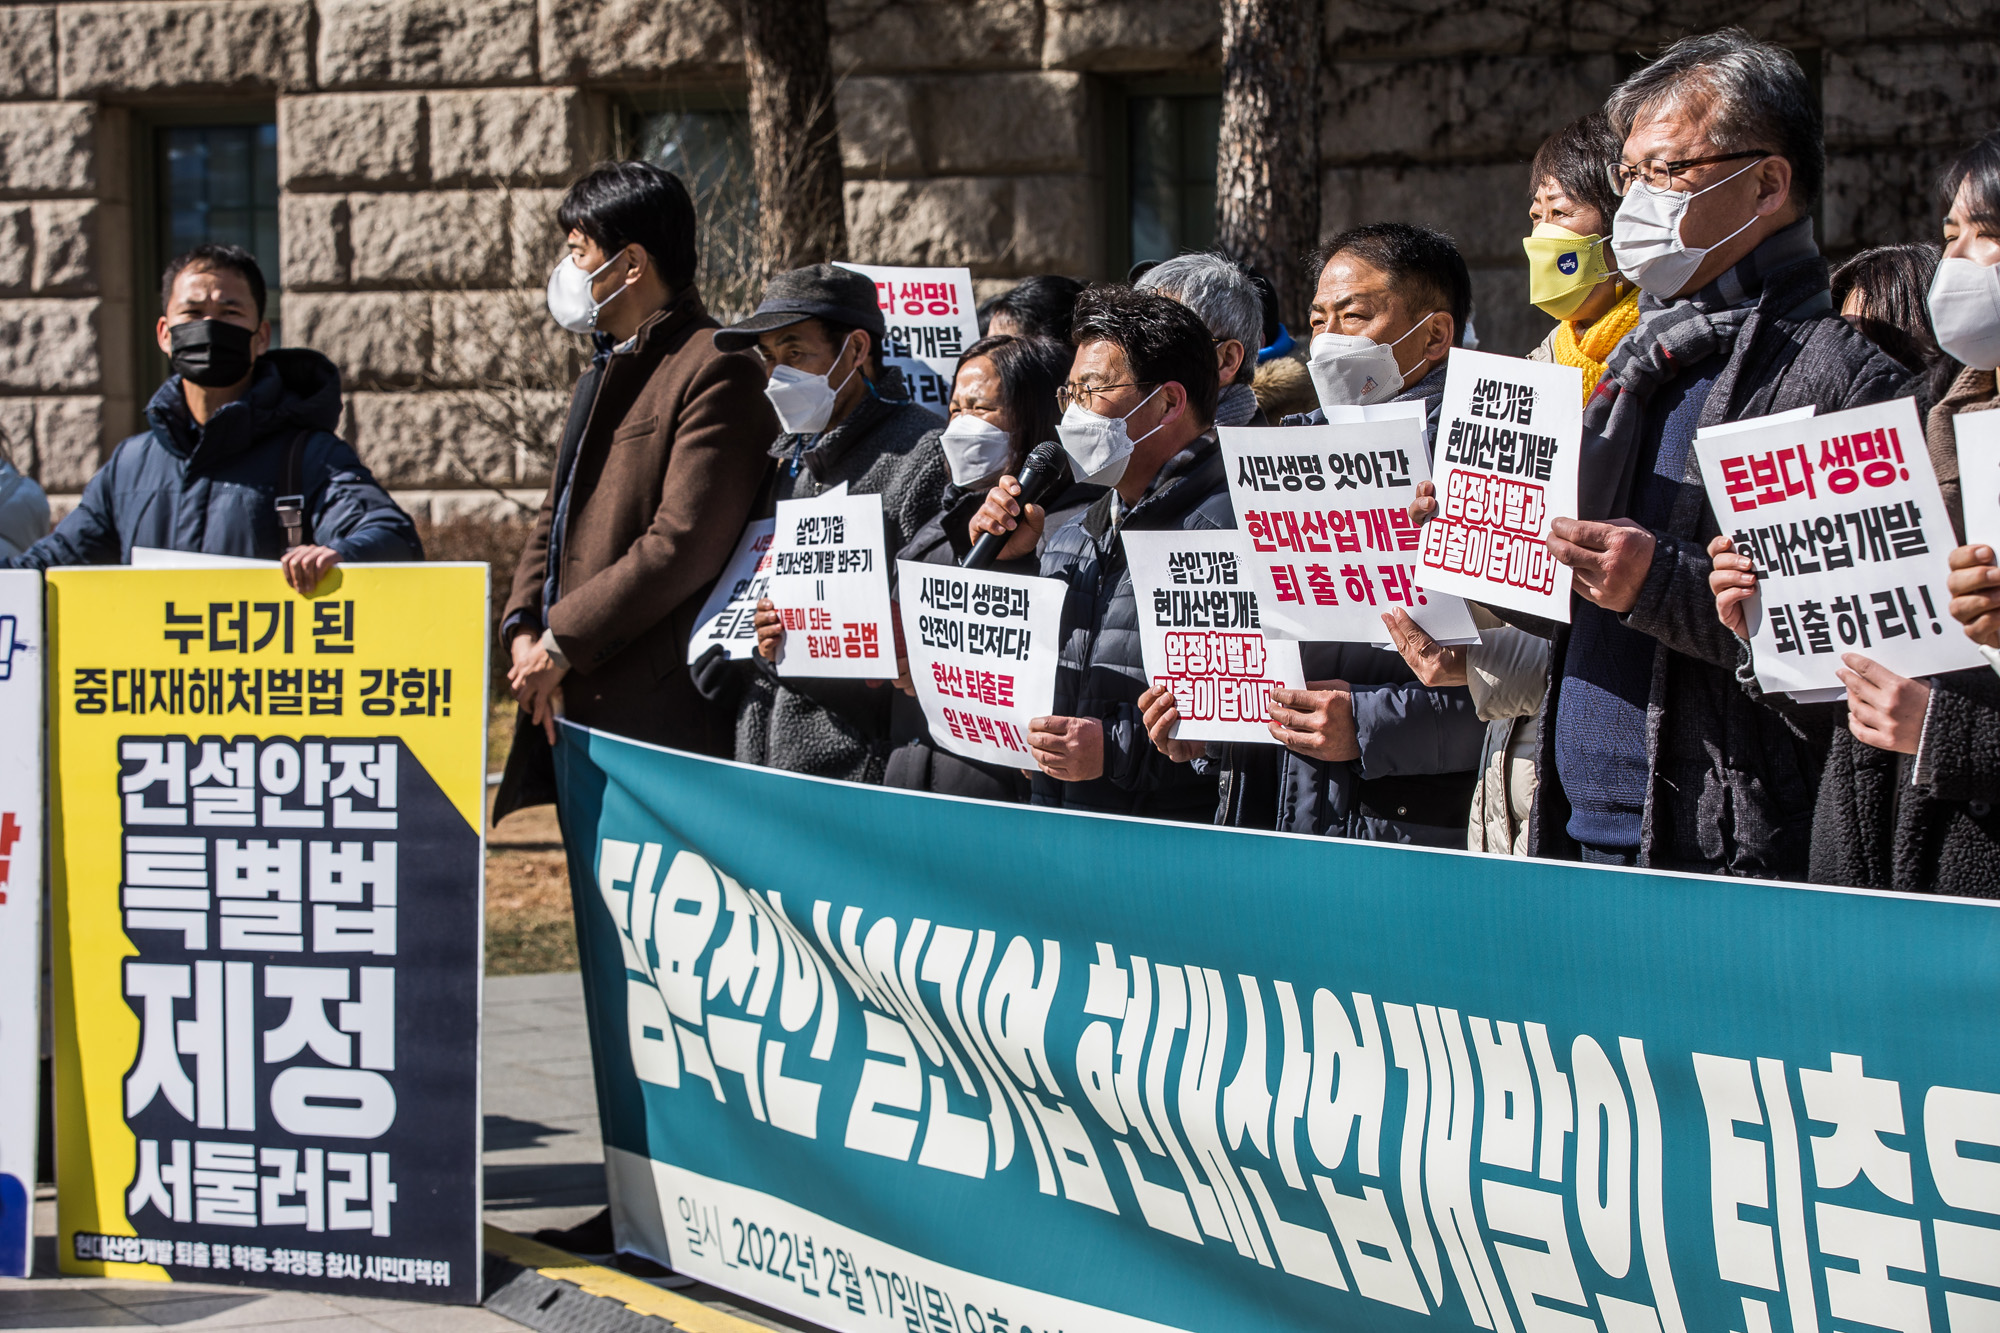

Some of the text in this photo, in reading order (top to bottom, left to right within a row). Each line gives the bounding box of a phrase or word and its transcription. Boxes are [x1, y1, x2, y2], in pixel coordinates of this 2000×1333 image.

[900, 282, 959, 316] 생명!
[1471, 378, 1534, 425] 살인기업
[1237, 449, 1411, 492] 시민생명 앗아간
[1445, 418, 1558, 481] 현대산업개발
[1720, 427, 1910, 512] 돈보다 생명!
[1446, 469, 1545, 537] 엄정처벌과
[796, 516, 844, 546] 살인기업
[1244, 508, 1422, 553] 현대산업개발
[1732, 500, 1930, 580] 현대산업개발
[776, 551, 835, 575] 현대산업개발
[838, 548, 872, 573] 봐주기
[1168, 552, 1238, 584] 살인기업
[1423, 517, 1558, 596] 퇴출이 답이다!
[809, 607, 832, 630] 되는
[920, 577, 1030, 621] 시민의 생명과
[164, 600, 354, 654] 누더기 된
[807, 623, 879, 658] 참사의 공범
[919, 615, 1031, 661] 안전이 먼저다!
[1165, 631, 1266, 677] 엄정처벌과
[74, 668, 452, 716] 중대재해처벌법 강화!
[932, 661, 1014, 707] 현산 퇴출로
[122, 741, 398, 830] 건설안전
[123, 836, 398, 955] 특별법
[126, 960, 396, 1139] 제정
[600, 838, 839, 1139] 탐욕적인
[813, 899, 1119, 1216] 살인기업
[128, 1139, 397, 1237] 서둘러라
[75, 1235, 173, 1266] 현대산업개발
[175, 1242, 210, 1269] 퇴출
[212, 1244, 231, 1270] 및
[325, 1251, 363, 1280] 참사
[363, 1255, 451, 1287] 시민대책위
[823, 1247, 866, 1315] 2월
